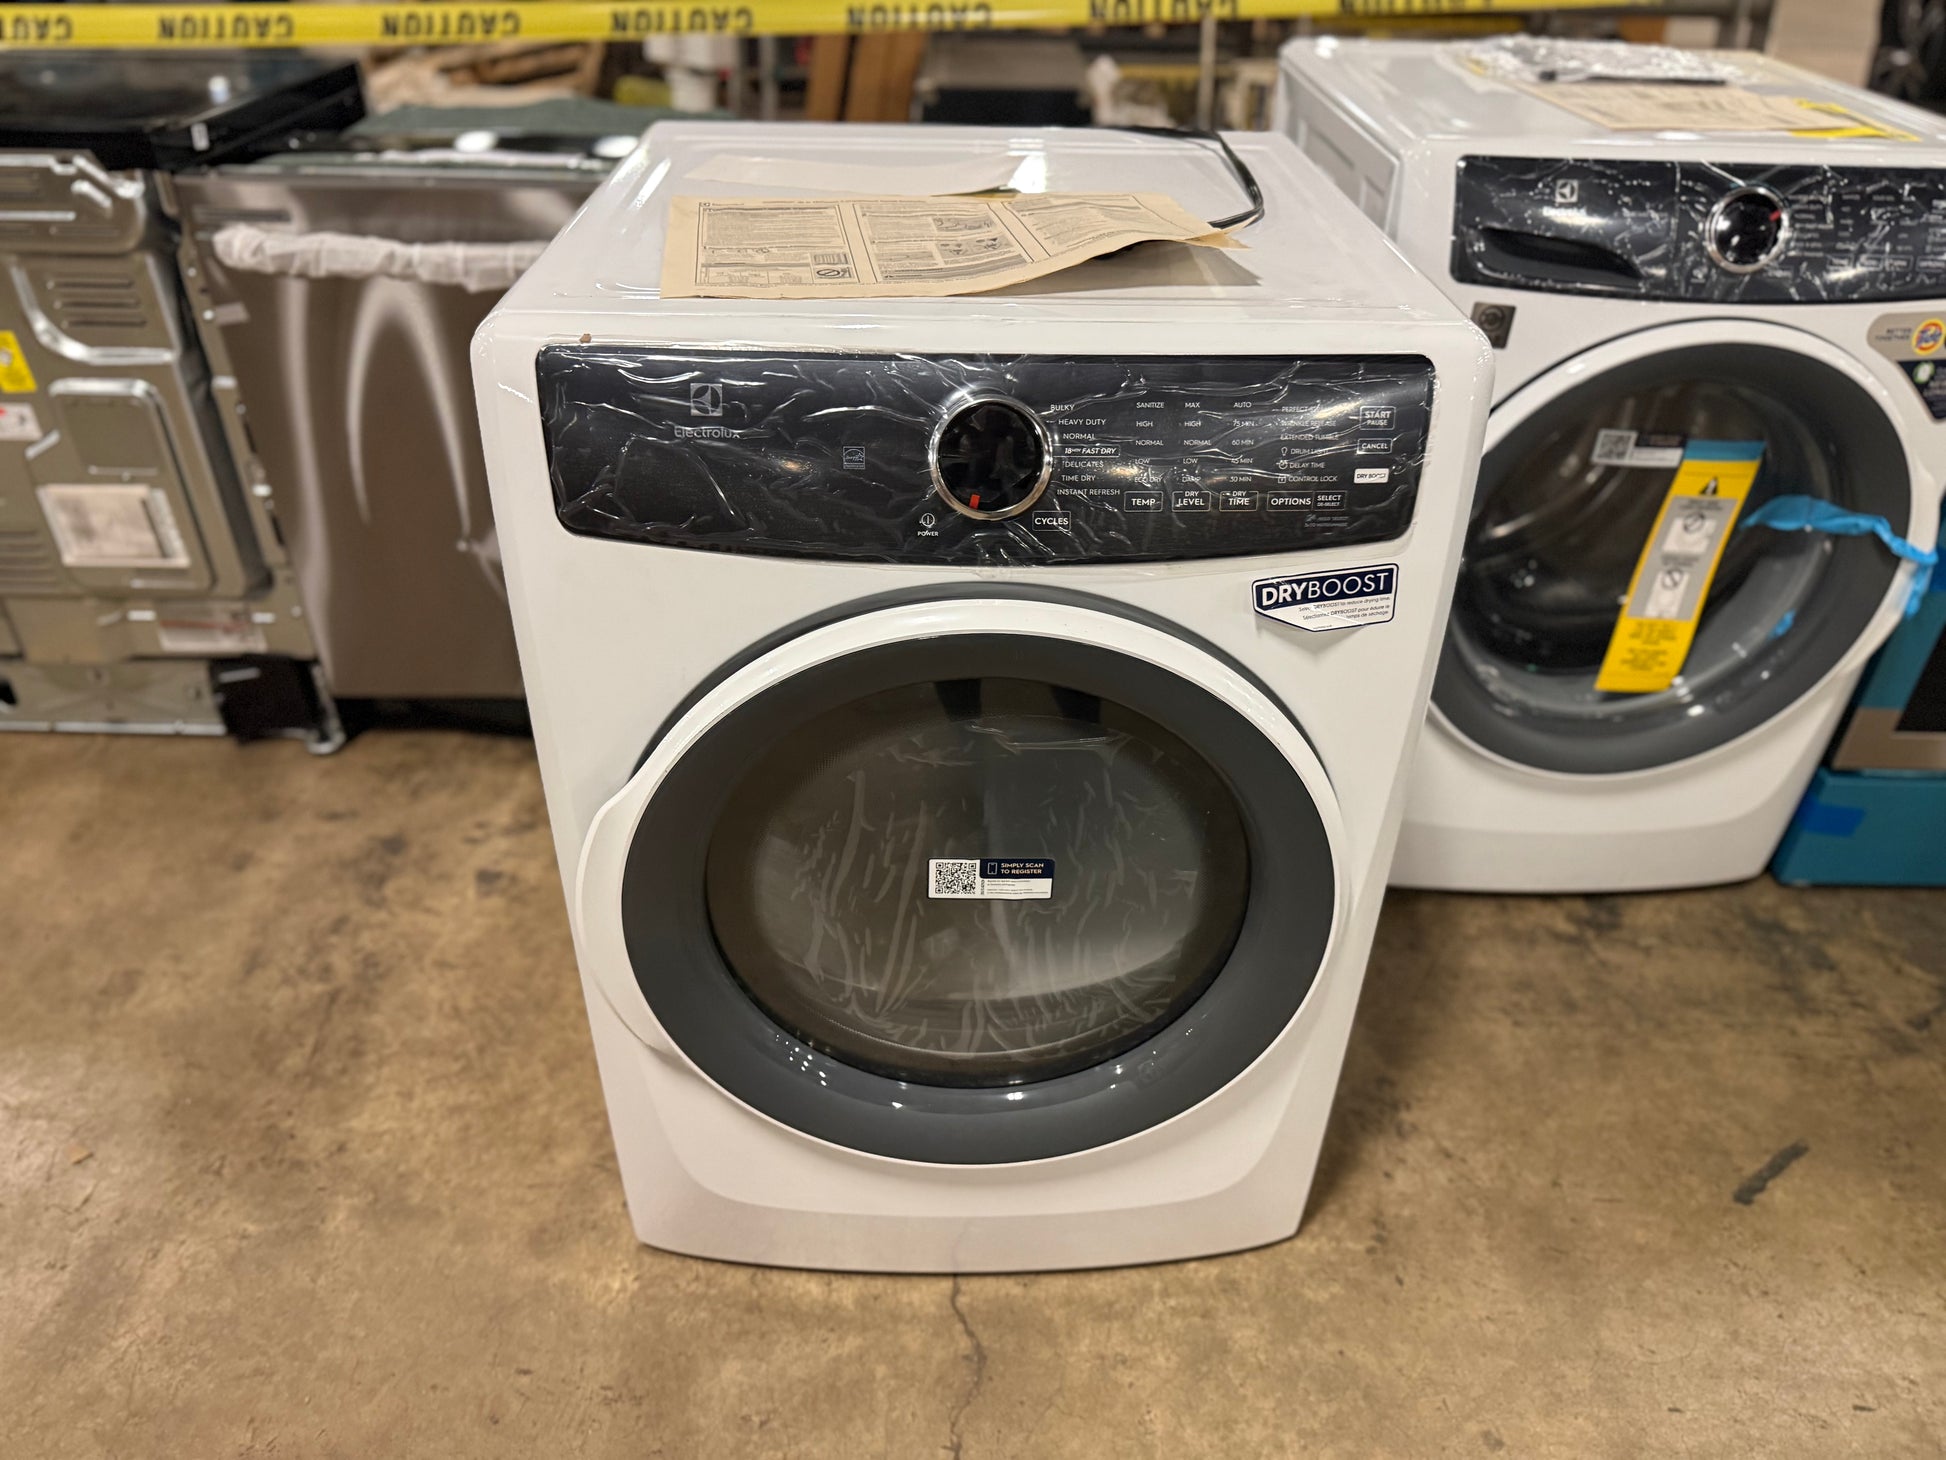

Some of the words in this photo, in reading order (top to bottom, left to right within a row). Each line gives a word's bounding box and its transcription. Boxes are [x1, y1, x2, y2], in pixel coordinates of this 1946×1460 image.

[157, 13, 295, 39] CAUTION
[381, 11, 521, 36] CAUTION
[611, 8, 754, 33] CAUTION
[1271, 498, 1311, 506] OPTIONS
[1262, 572, 1389, 606] DRYBOOST
